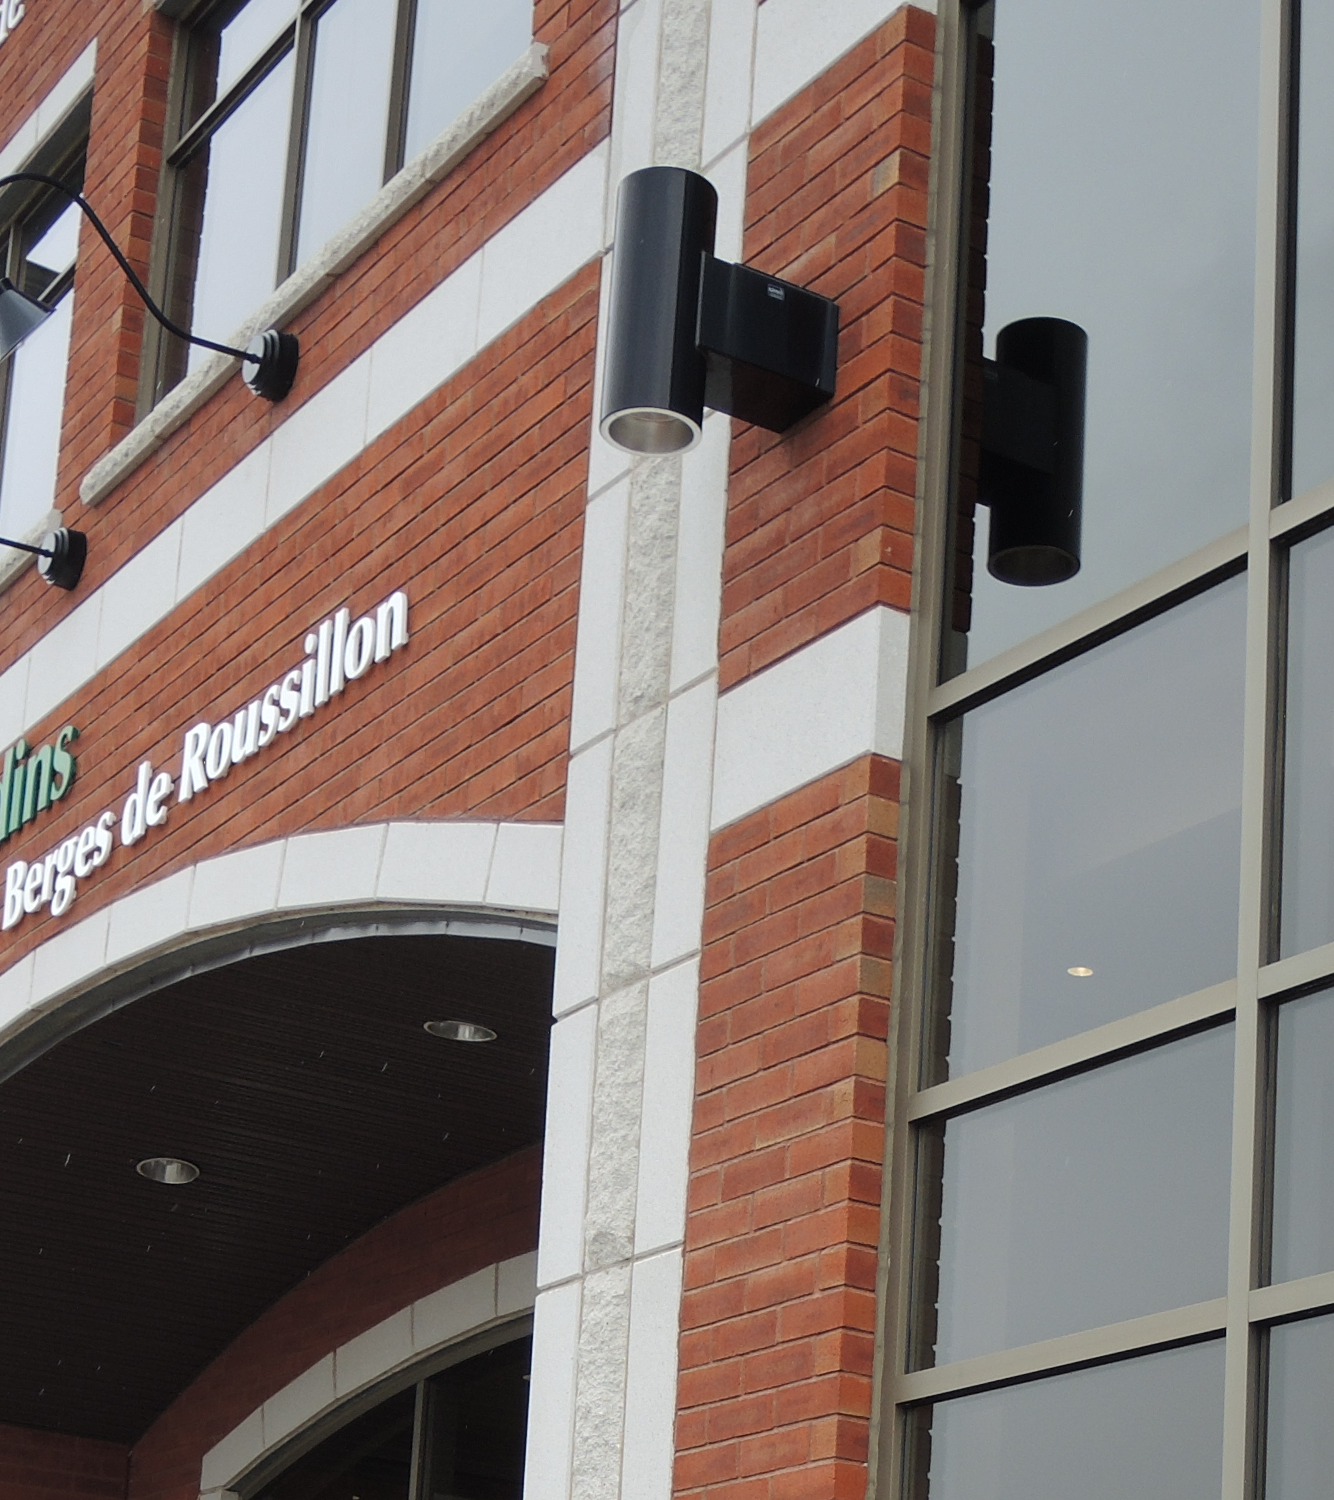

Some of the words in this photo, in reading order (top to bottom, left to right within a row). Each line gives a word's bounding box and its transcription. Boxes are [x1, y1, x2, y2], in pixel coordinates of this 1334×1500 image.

[2, 810, 116, 930] Berges
[121, 761, 173, 846] de
[178, 590, 409, 802] Roussillon
